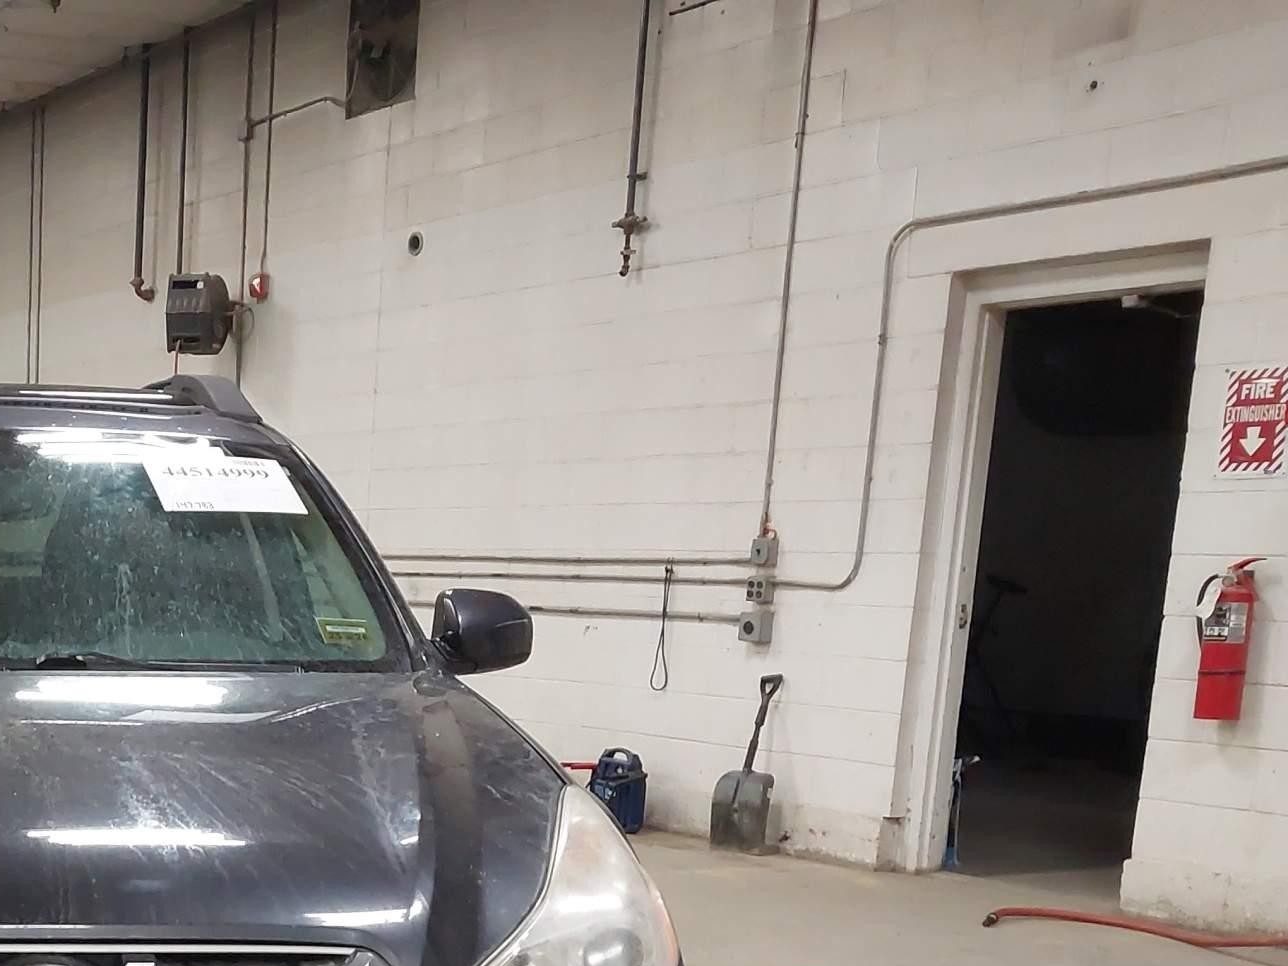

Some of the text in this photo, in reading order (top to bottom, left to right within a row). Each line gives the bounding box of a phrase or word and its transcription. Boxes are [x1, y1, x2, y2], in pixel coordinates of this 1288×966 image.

[1241, 381, 1276, 400] FIRE
[1226, 404, 1286, 423] EXTINGUISHER
[162, 466, 269, 478] 44514999
